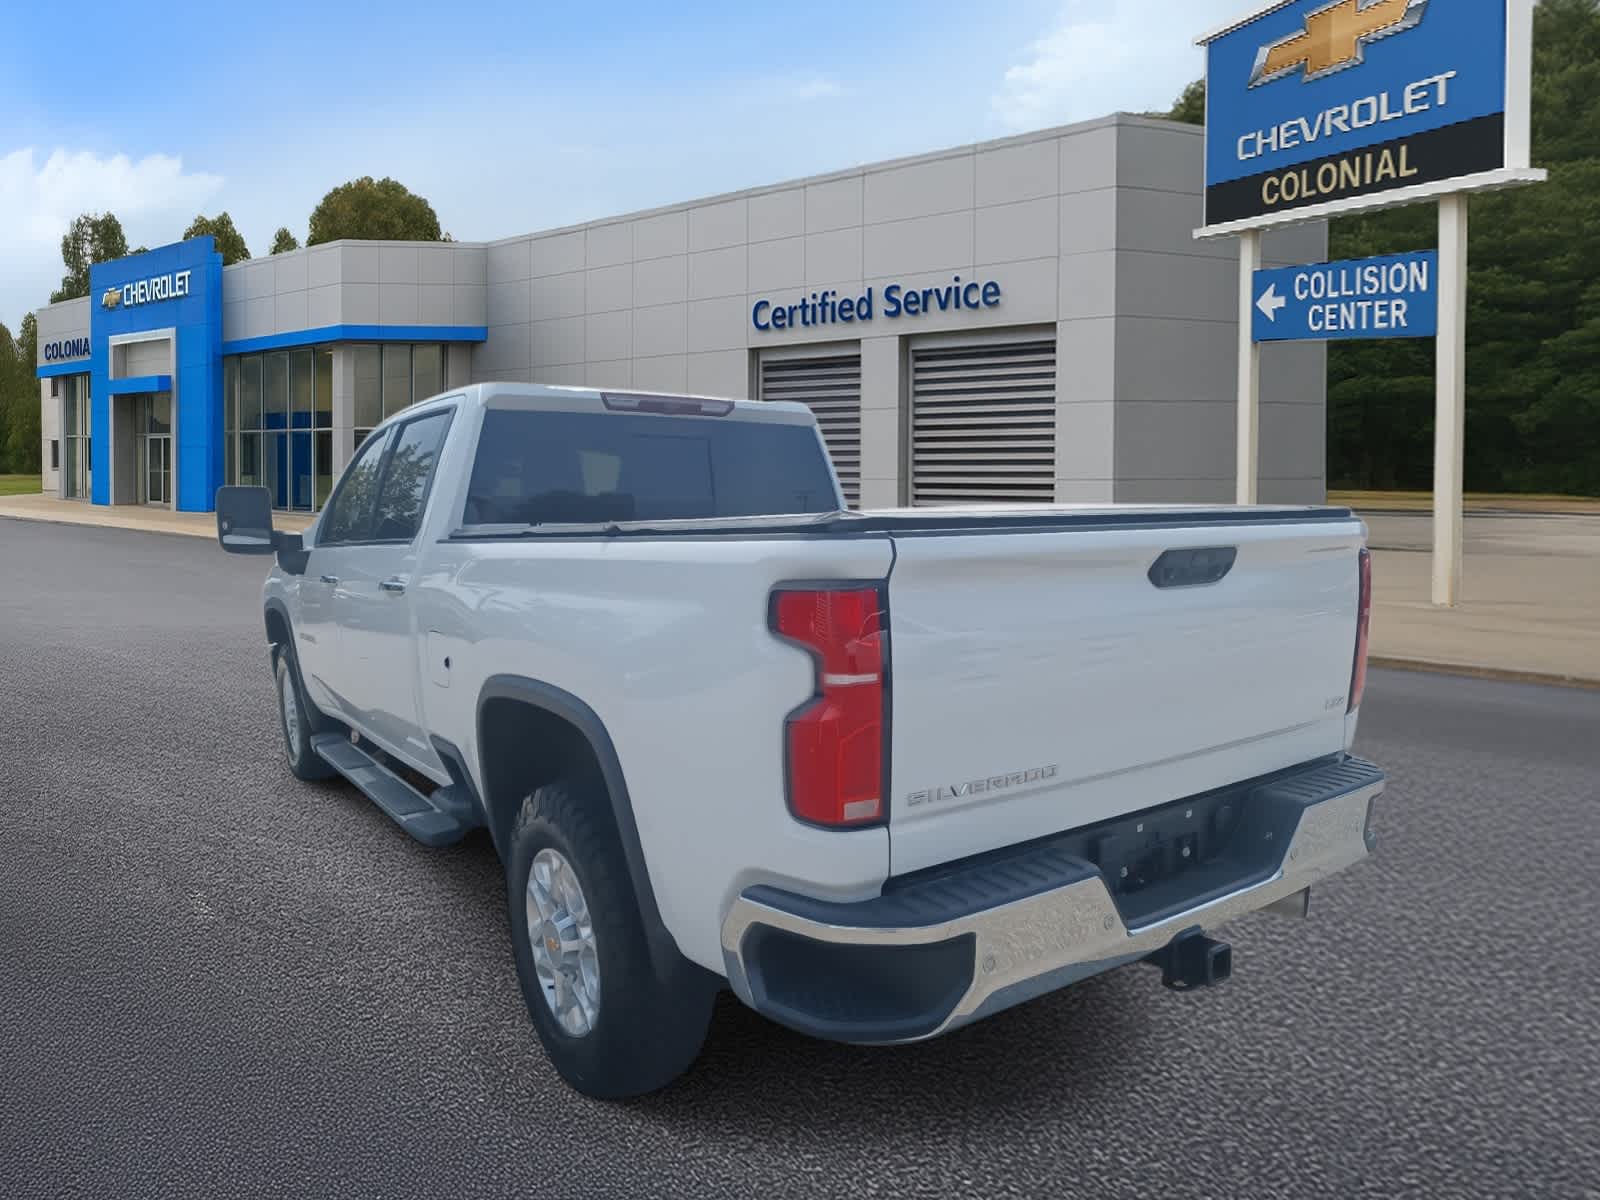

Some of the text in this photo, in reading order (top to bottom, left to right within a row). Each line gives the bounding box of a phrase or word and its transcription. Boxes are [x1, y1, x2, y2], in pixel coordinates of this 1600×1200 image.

[1237, 70, 1457, 160] CHEVROLET
[1262, 145, 1417, 204] COLONIAL
[124, 270, 191, 305] CHEVROLET
[1294, 261, 1428, 300] COLLISION
[752, 275, 1001, 331] Certified Service
[1308, 299, 1408, 331] CENTER
[907, 763, 1060, 807] SILVERADO
